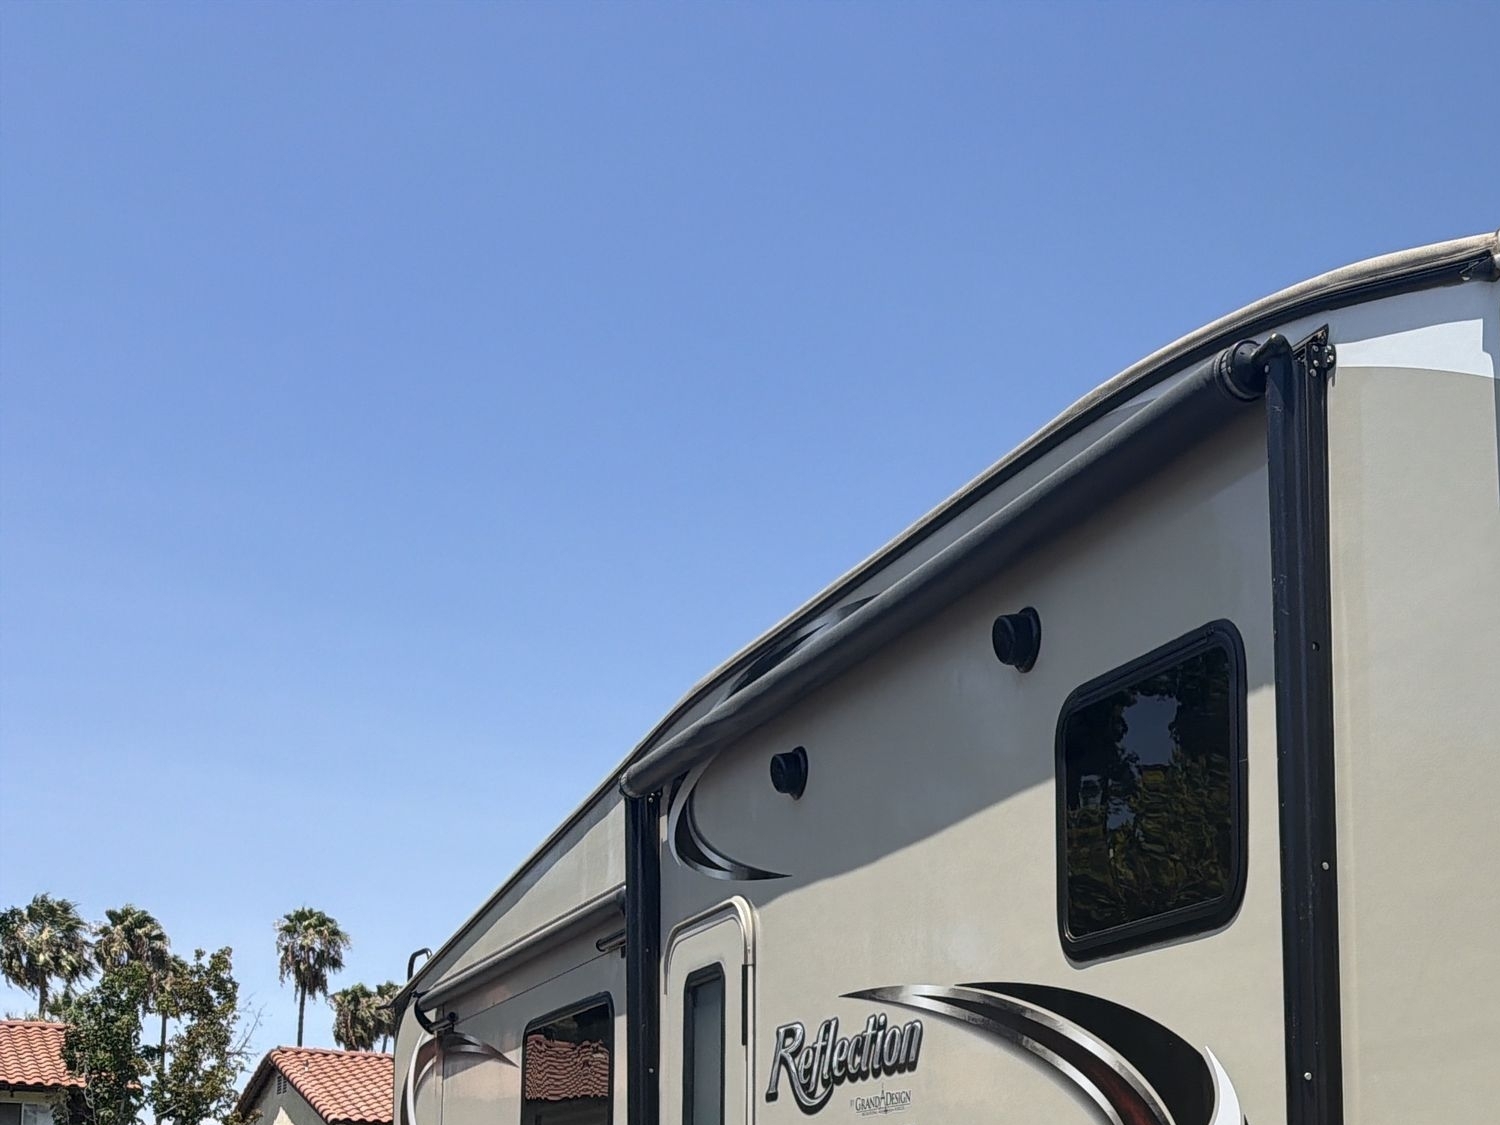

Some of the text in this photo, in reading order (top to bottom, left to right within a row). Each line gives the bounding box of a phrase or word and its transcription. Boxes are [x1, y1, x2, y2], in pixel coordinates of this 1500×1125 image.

[765, 1012, 924, 1116] Reflection
[855, 1095, 881, 1111] GRAND
[885, 1090, 912, 1106] DESIGN
